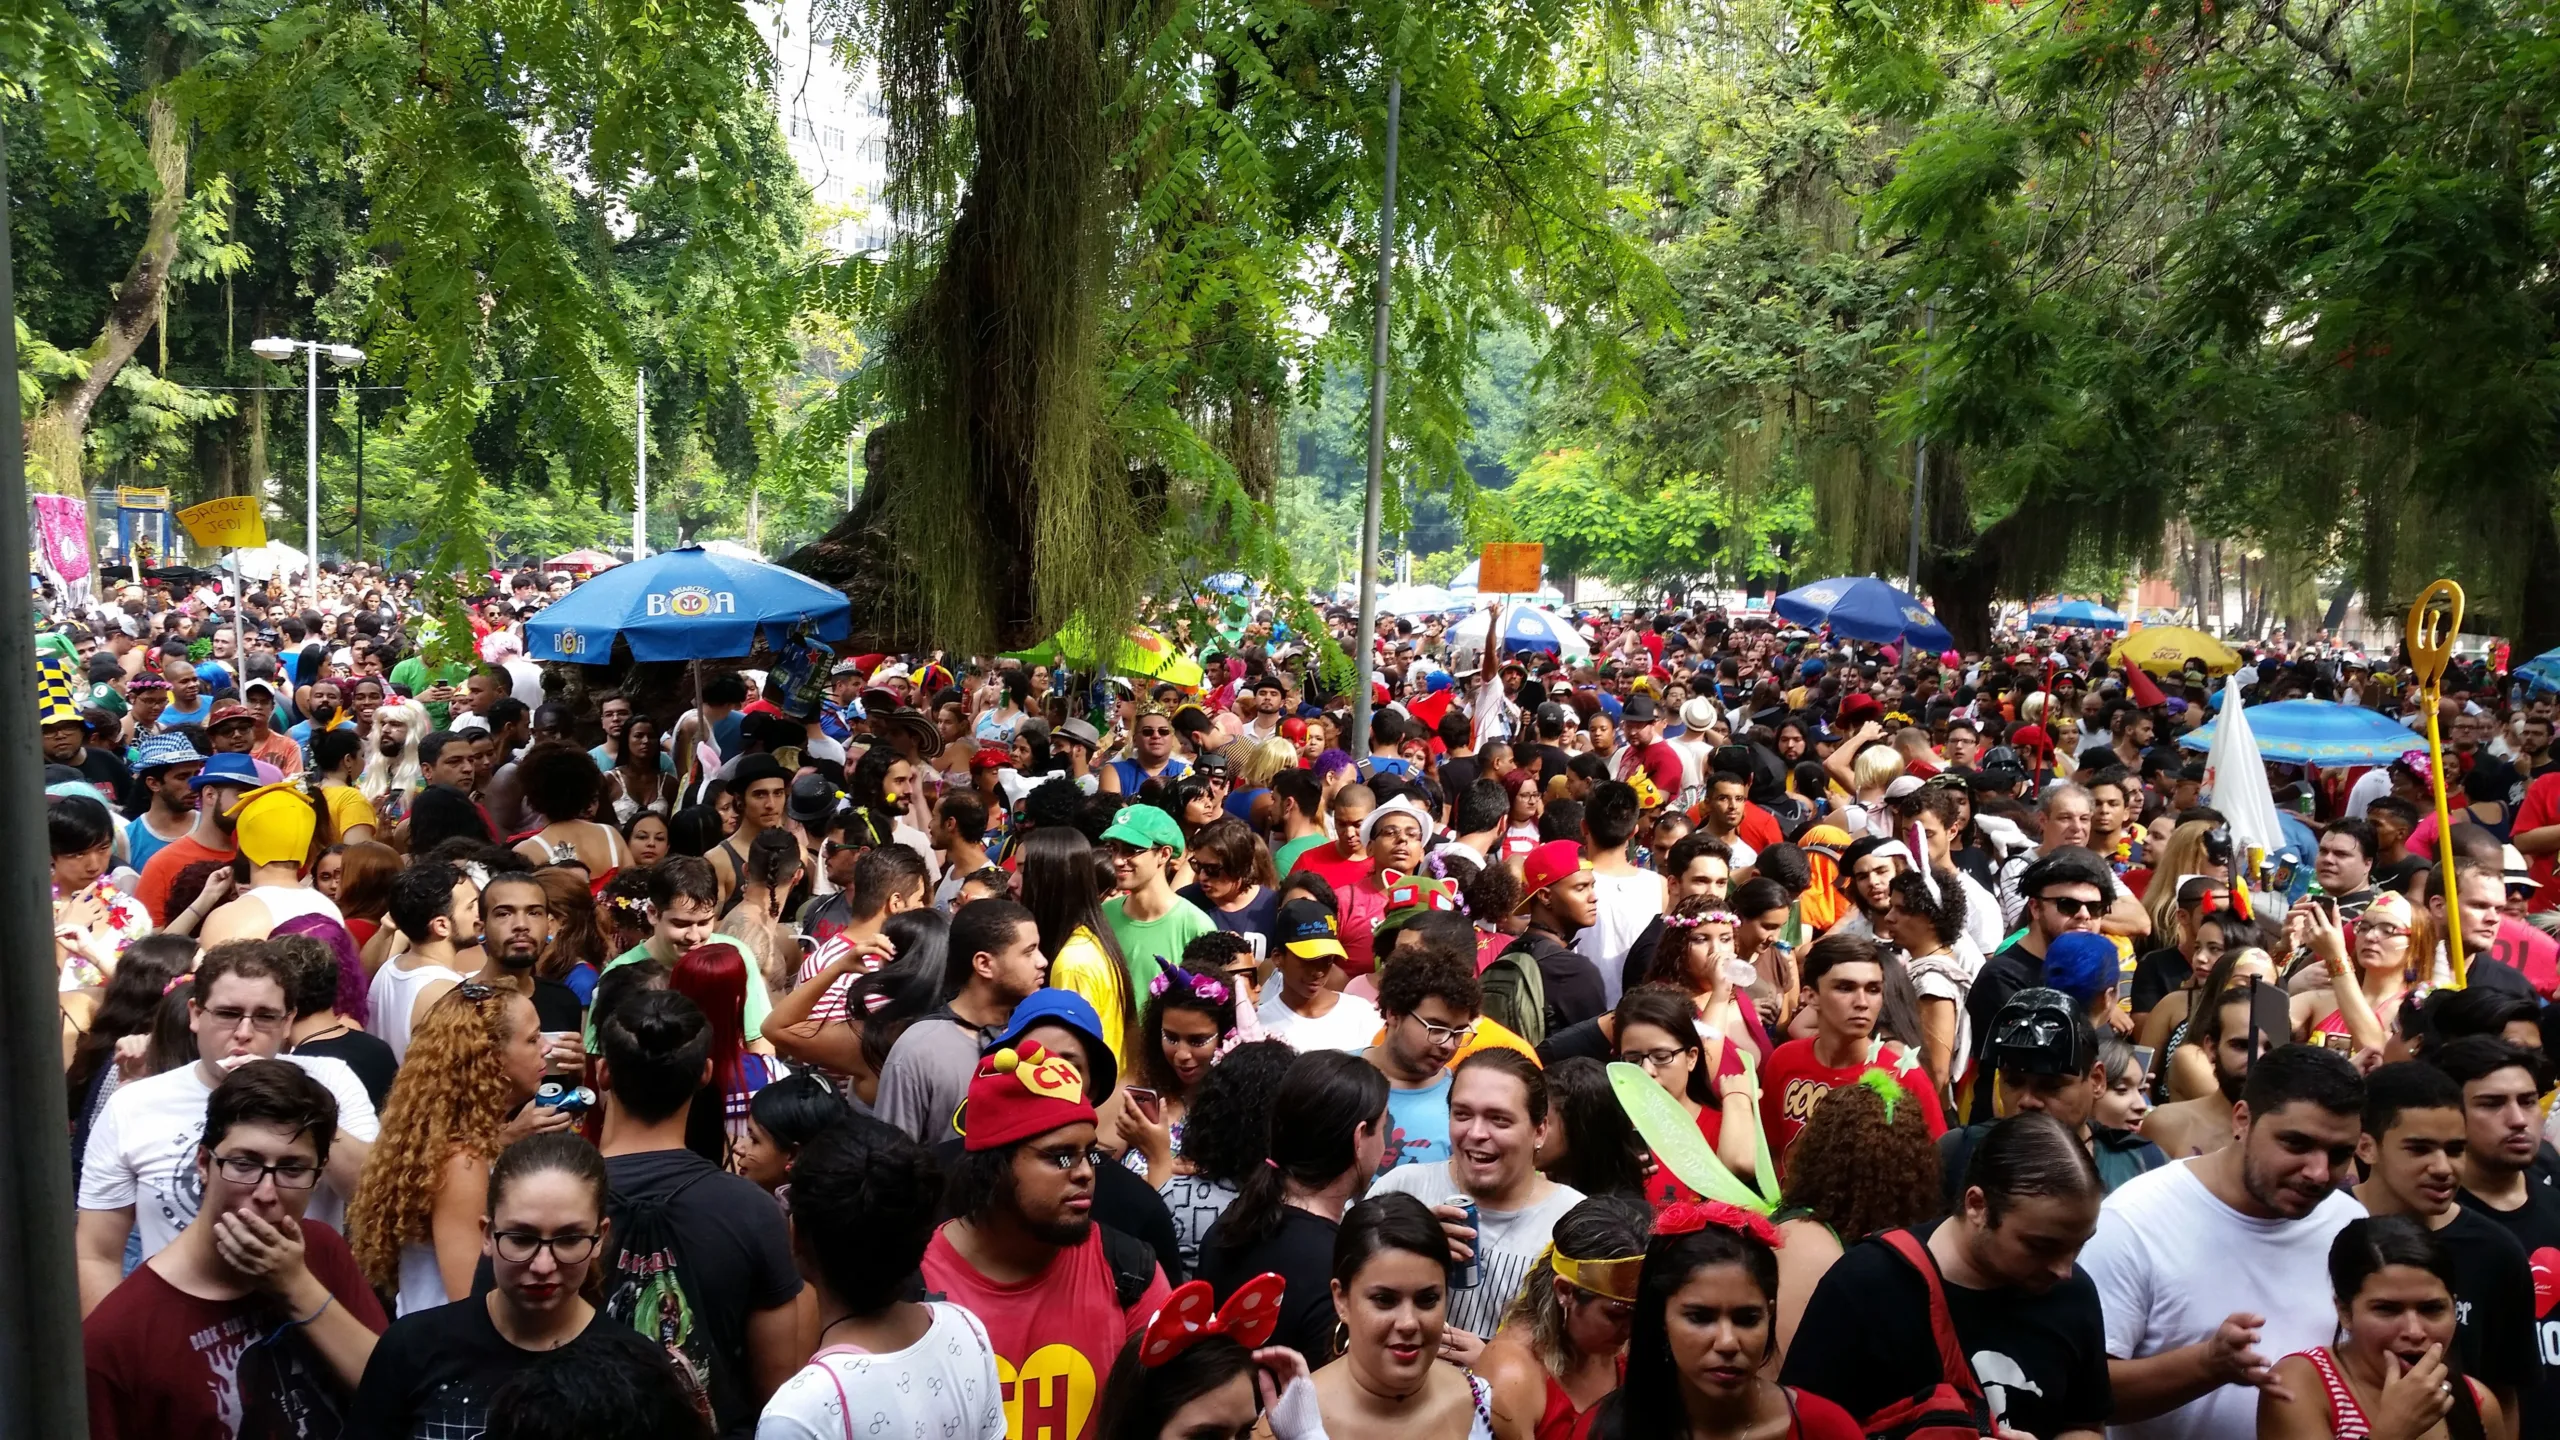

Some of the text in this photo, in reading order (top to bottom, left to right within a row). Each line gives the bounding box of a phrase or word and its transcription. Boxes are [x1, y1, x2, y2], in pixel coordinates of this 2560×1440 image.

[184, 498, 246, 526] SACOLÉ
[206, 518, 241, 534] JEDI
[1033, 1063, 1081, 1090] CH
[999, 1373, 1069, 1440] H
